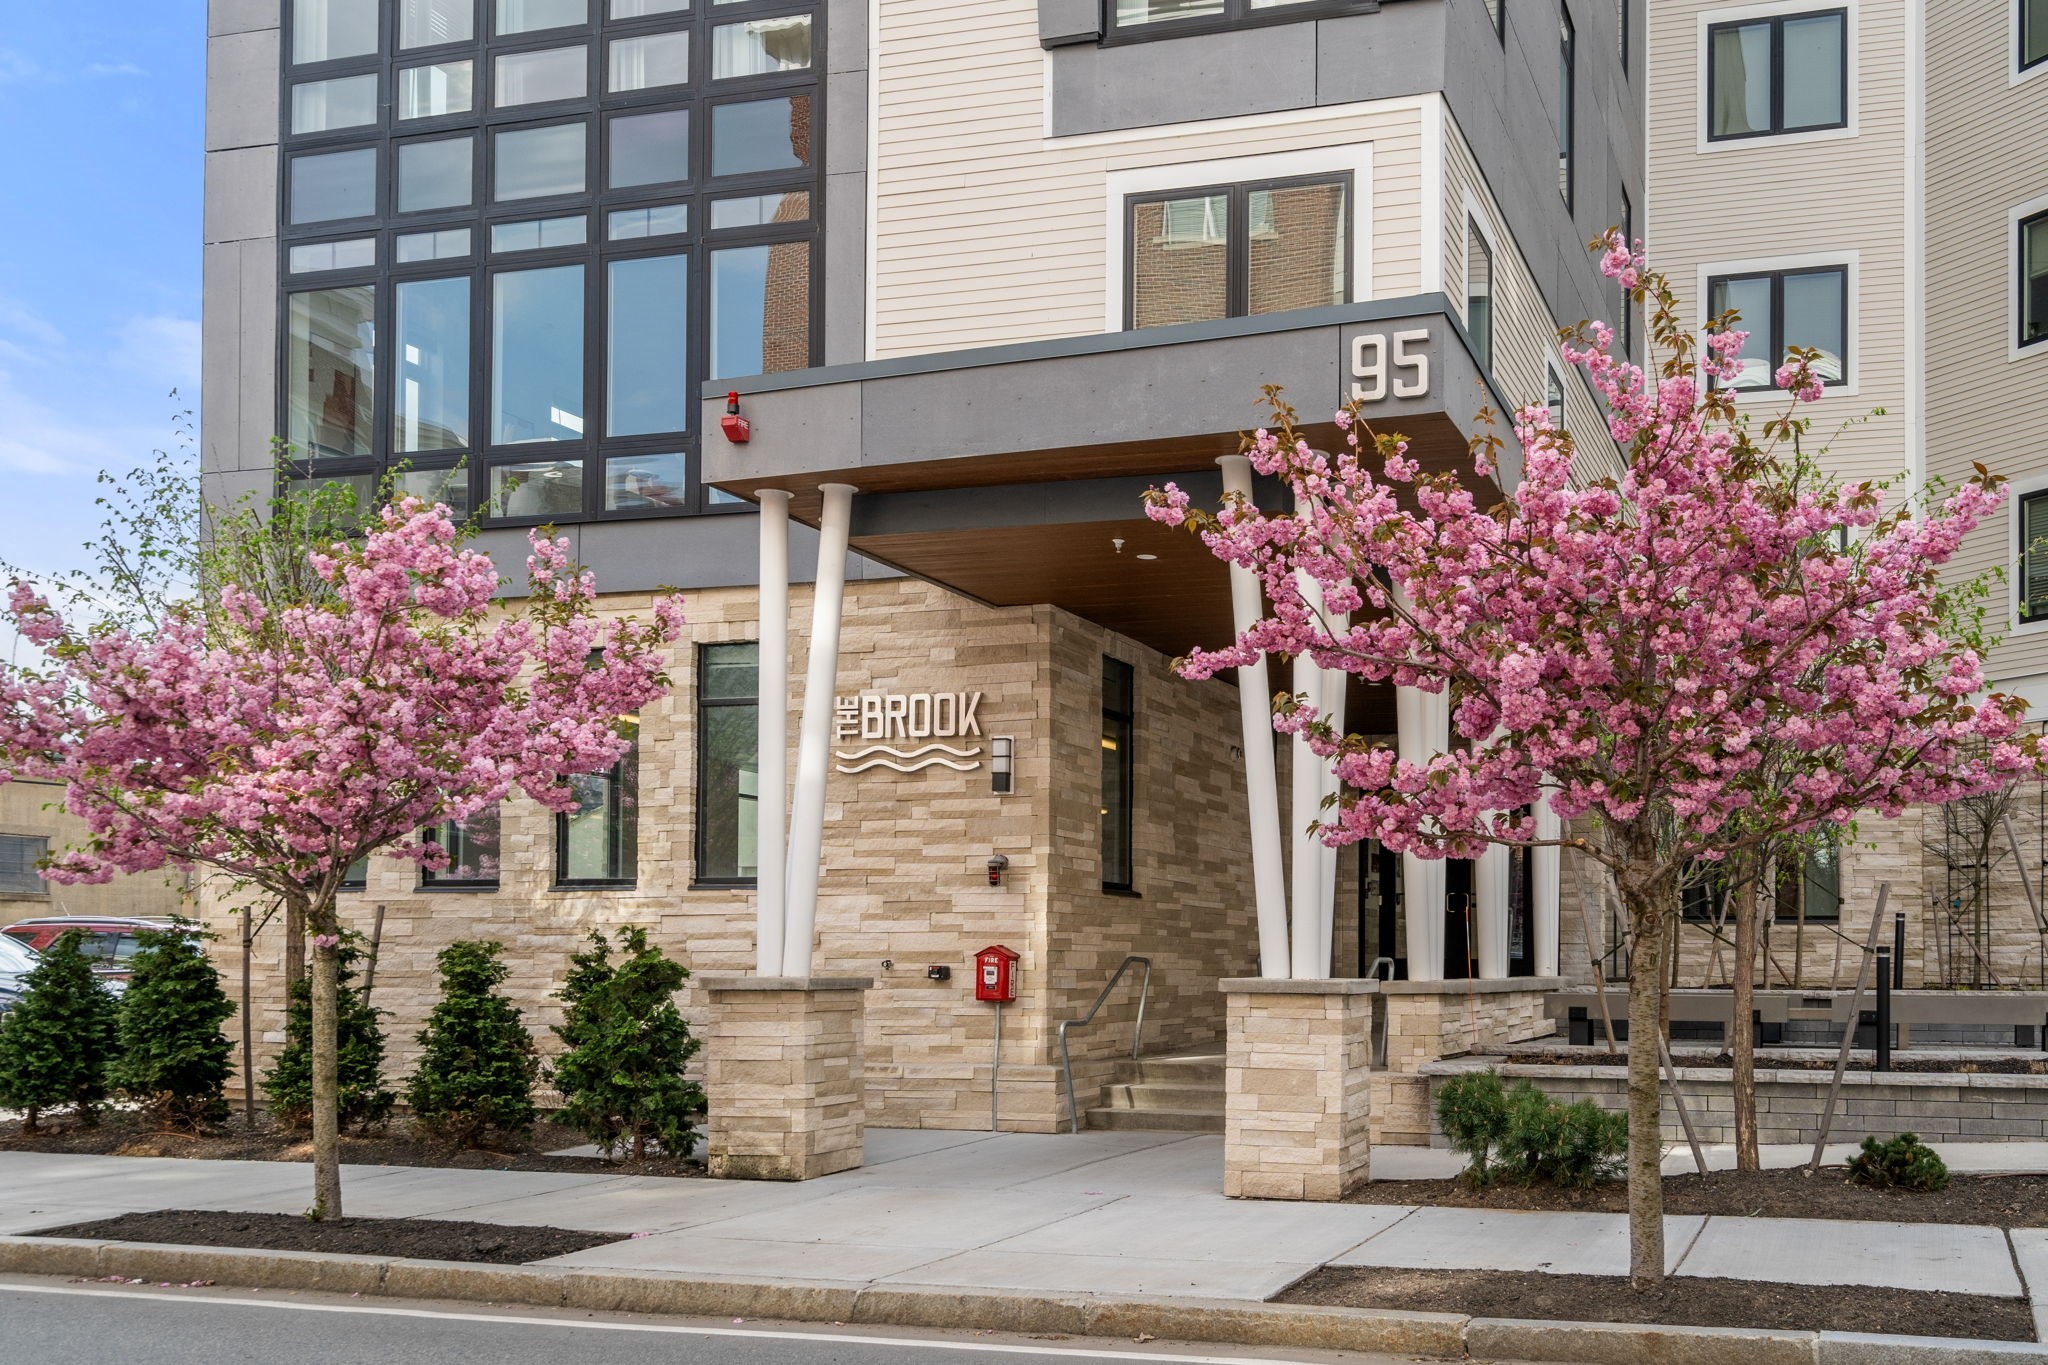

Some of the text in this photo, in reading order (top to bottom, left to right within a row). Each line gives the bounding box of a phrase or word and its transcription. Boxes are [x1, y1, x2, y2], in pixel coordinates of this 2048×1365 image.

[1351, 328, 1429, 401] 95
[836, 691, 982, 739] THE BROOK
